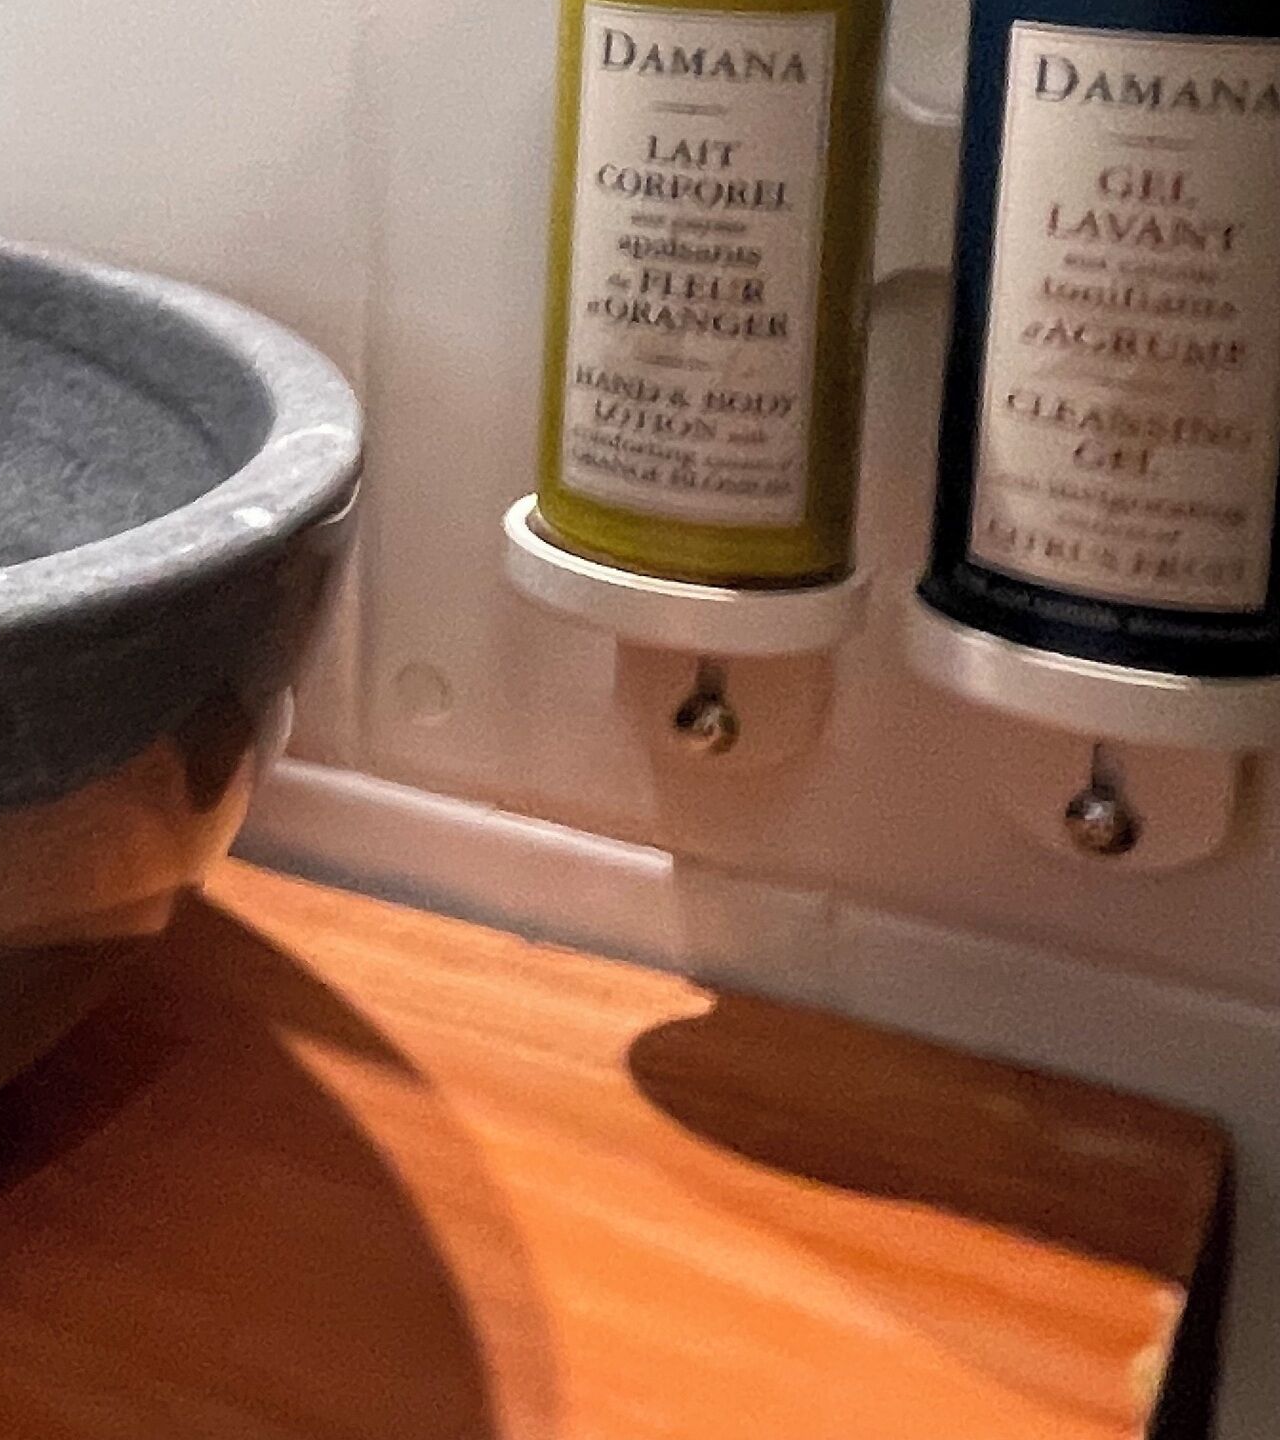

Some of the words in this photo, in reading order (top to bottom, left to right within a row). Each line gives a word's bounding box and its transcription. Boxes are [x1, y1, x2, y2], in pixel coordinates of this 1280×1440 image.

[600, 26, 807, 84] DAMANA
[1035, 54, 1280, 113] DAMANA
[646, 133, 742, 169] LAIT
[1045, 202, 1245, 251] LAVANT
